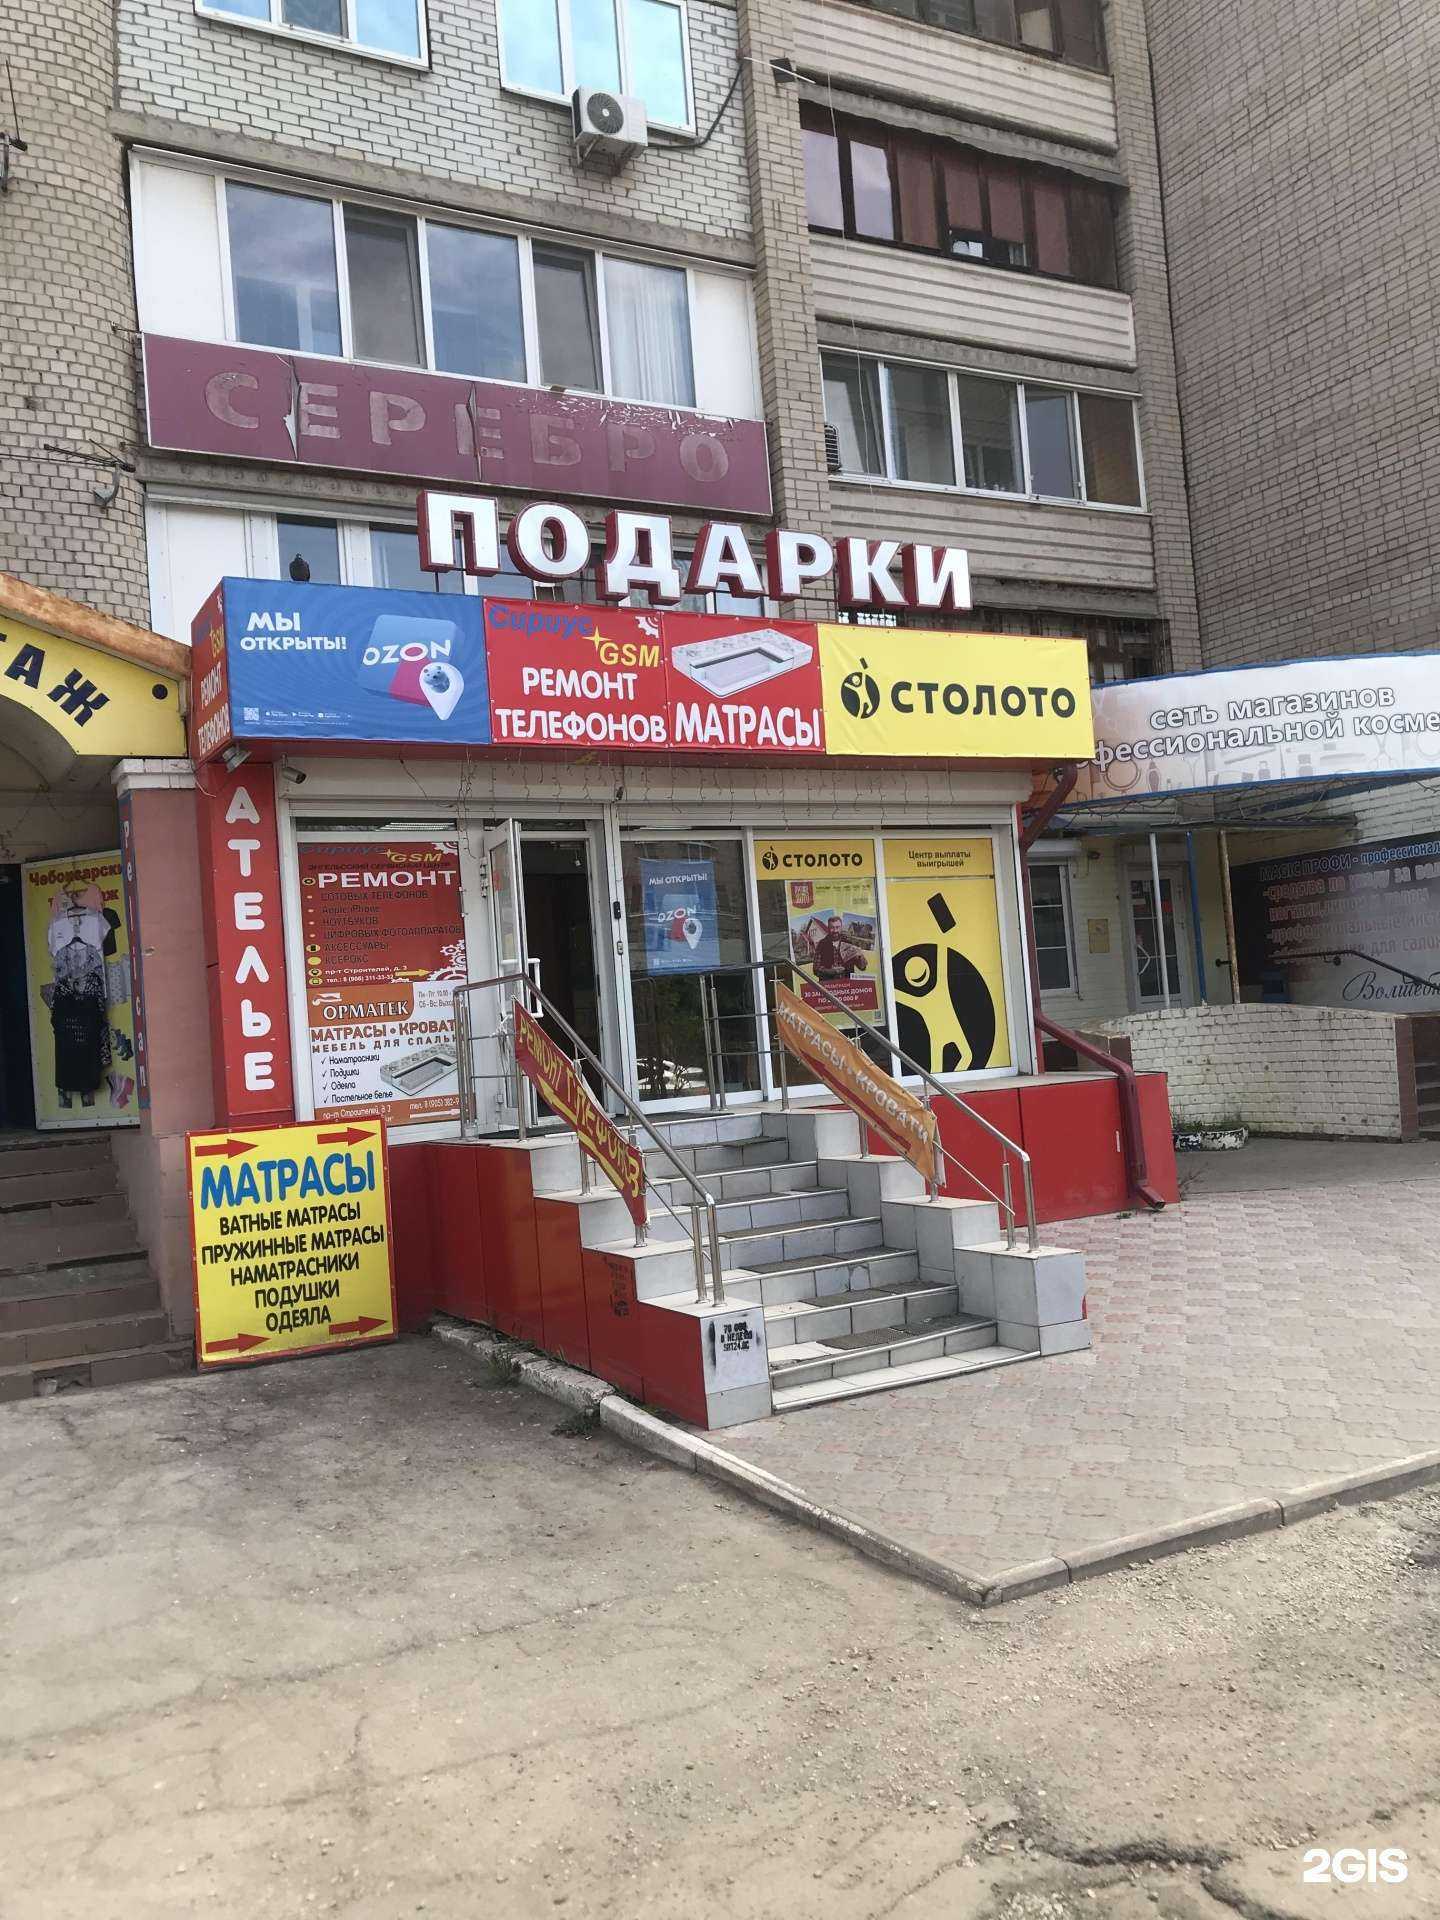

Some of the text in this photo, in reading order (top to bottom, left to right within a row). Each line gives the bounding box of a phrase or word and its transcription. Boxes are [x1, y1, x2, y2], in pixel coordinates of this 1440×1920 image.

[203, 371, 730, 482] СЕРЕБРО
[418, 490, 973, 613] ПОДАРКИ
[247, 612, 300, 632] МЫ
[488, 604, 593, 639] Сириус
[240, 633, 347, 652] ОТКРЫТЫ!
[363, 640, 451, 666] OZON
[599, 641, 660, 668] GSM
[0, 633, 110, 727] АЖ
[522, 667, 637, 700] РЕМОНТ
[891, 681, 1075, 718] СТОЛОТО
[1150, 687, 1395, 731] сеть магазинов
[495, 708, 667, 743] ТЕЛЕФОНОВ
[675, 702, 820, 746] МАТРАСЫ
[391, 853, 442, 863] GSM
[782, 852, 863, 868] СТОЛОТО
[908, 849, 971, 860] Центр выплаты
[916, 859, 964, 869] выигрышей
[318, 870, 457, 888] РЕМОНТ
[649, 877, 663, 886] МЫ
[657, 905, 696, 922] OZON
[225, 786, 275, 1091] АТЕЛЬЕ
[323, 1001, 409, 1021] ОРМАТЕК
[311, 1019, 457, 1042] МАТРАСЫ КРОВАТ
[312, 1041, 366, 1053] МЕБЕЛЬ
[374, 1038, 400, 1050] ДЛЯ
[518, 1014, 564, 1091] РЕМОНТ
[330, 1069, 360, 1080] Подушки
[777, 1000, 929, 1144] МАТРАСЫ КРОВАТИ
[200, 1150, 376, 1210] МАТРАСЫ
[219, 1201, 361, 1236] ВАТНЫЕ МАТРАСЫ
[201, 1224, 385, 1265] ПРУЖИННЫЕ МАТРАСЫ
[230, 1252, 360, 1286] НАМАТРАСНИКИ
[254, 1279, 340, 1309] ПОДУШКИ
[265, 1305, 332, 1334] ОДЕЯЛА
